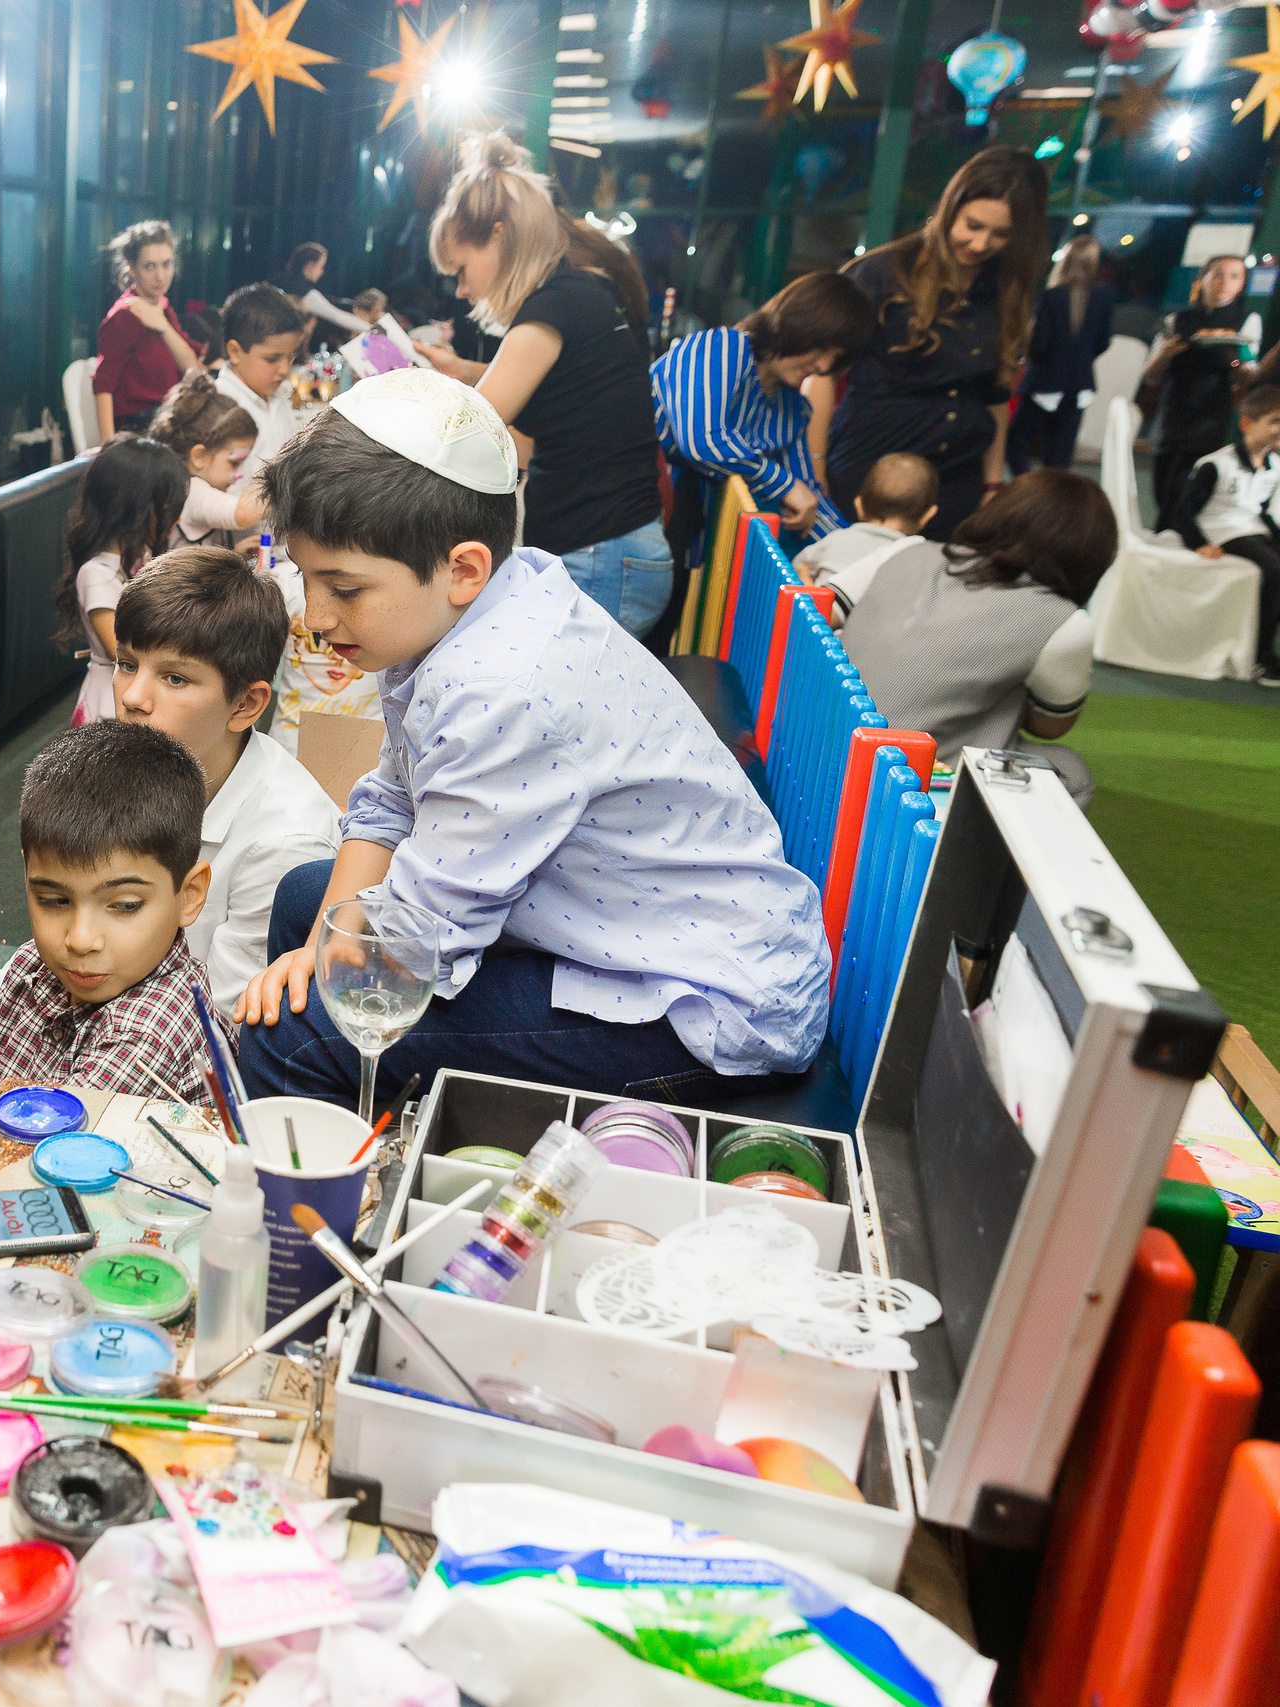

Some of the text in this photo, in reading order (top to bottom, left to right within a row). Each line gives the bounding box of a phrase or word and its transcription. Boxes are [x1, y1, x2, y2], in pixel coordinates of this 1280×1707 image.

[107, 1260, 160, 1284] TAG
[10, 1280, 61, 1306] TAG
[95, 1327, 125, 1360] TAG
